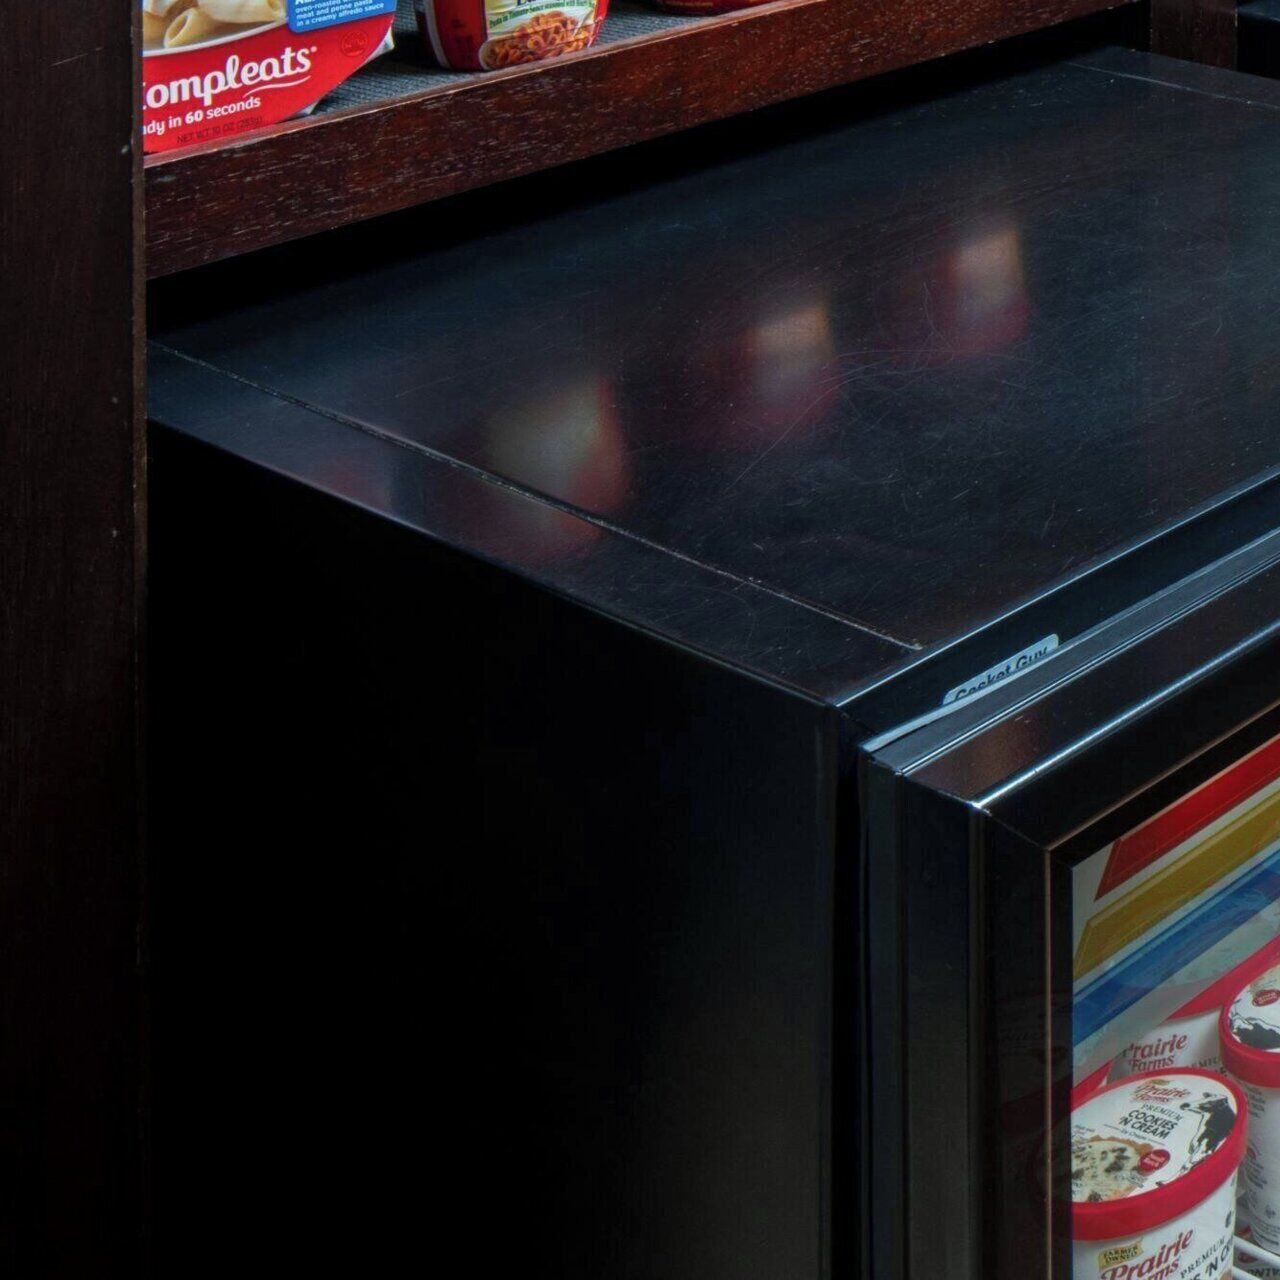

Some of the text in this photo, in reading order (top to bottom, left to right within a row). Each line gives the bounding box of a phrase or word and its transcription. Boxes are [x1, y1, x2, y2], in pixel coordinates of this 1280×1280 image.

[364, 1, 385, 12] sauce
[143, 47, 312, 110] ompleats
[168, 115, 182, 129] in
[184, 109, 204, 125] 60
[206, 95, 262, 120] seconds
[1128, 1109, 1179, 1131] COOKIES
[1130, 1120, 1171, 1140] CREAM
[1101, 1228, 1195, 1280] Prairie
